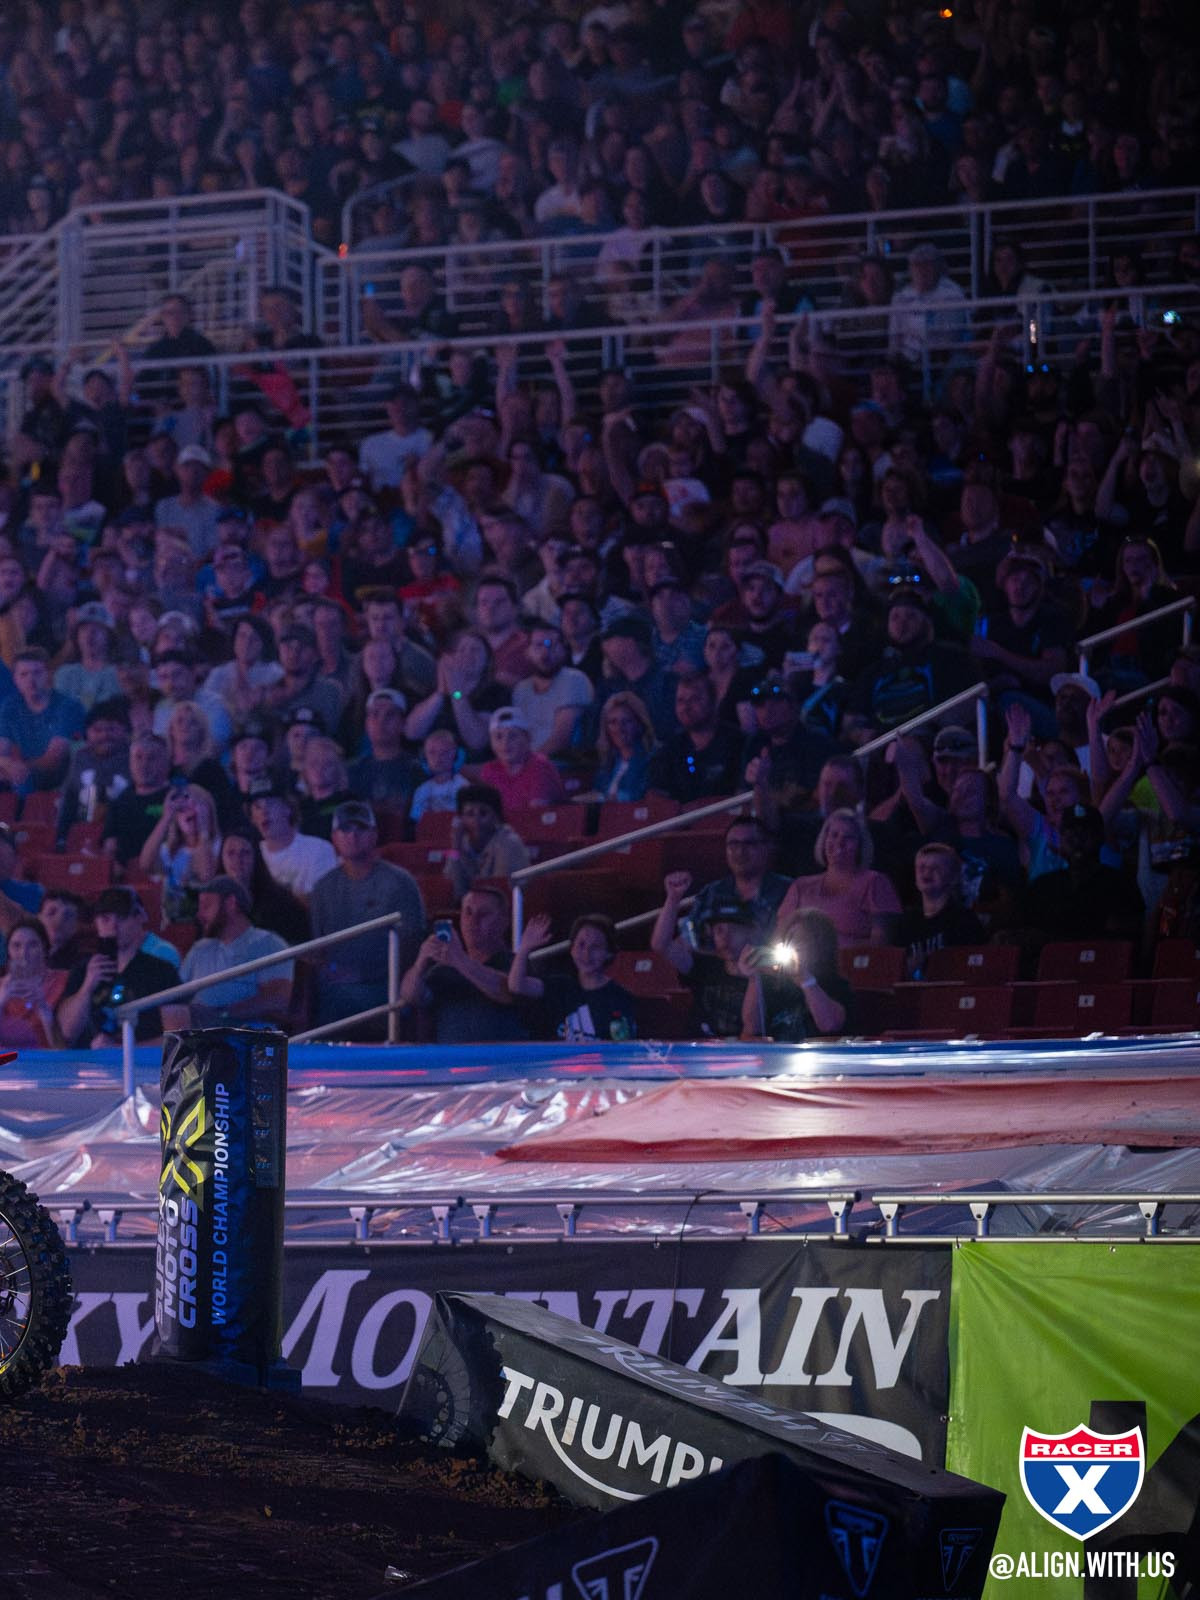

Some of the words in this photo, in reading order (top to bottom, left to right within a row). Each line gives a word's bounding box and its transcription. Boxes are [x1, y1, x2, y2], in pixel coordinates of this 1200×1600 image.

[213, 1082, 230, 1246] CHAMPIONSHIP
[164, 1199, 179, 1319] MOTO
[179, 1197, 198, 1329] CROSS
[211, 1250, 228, 1326] WORLD
